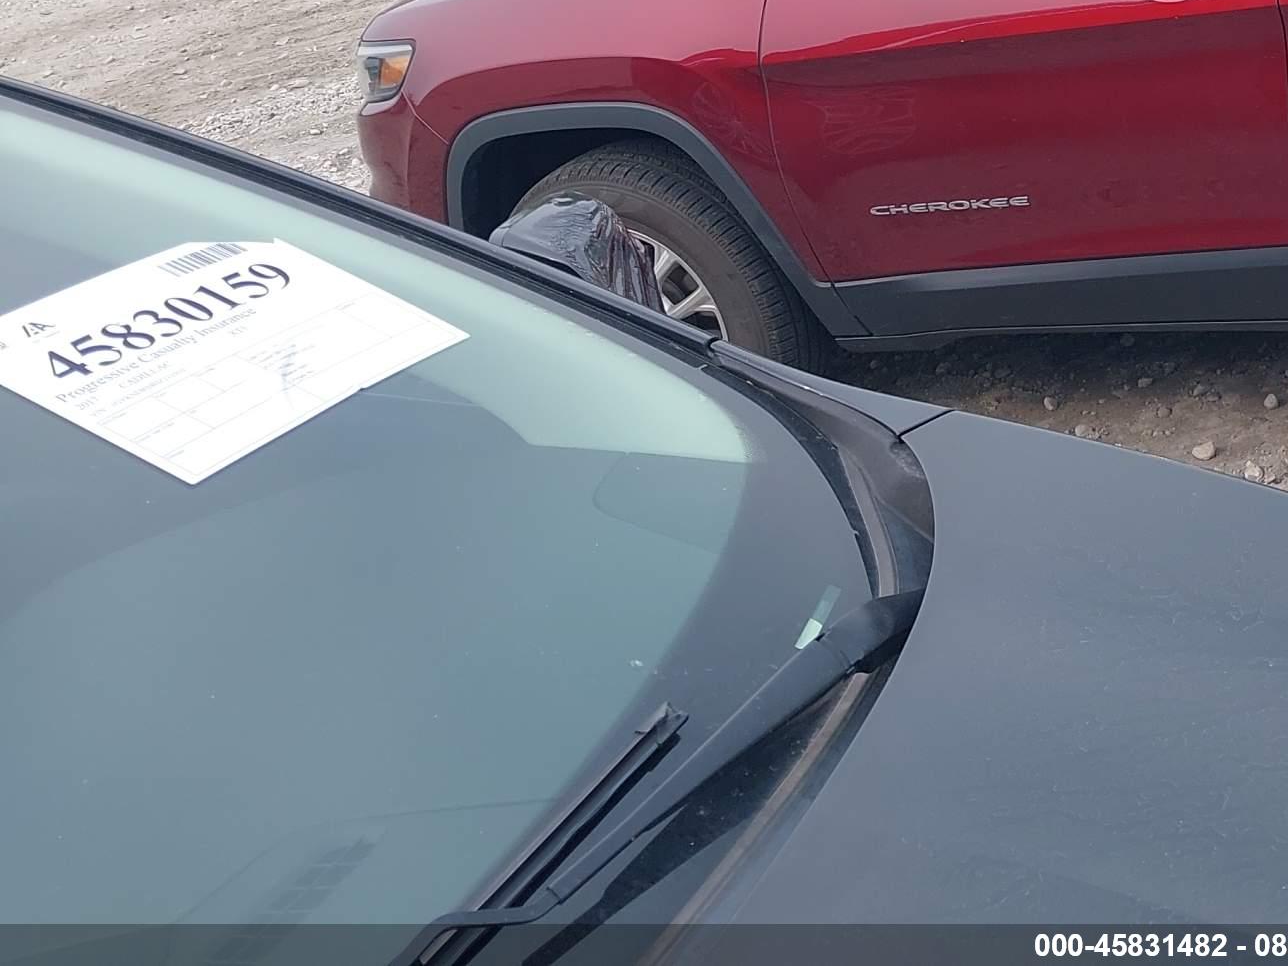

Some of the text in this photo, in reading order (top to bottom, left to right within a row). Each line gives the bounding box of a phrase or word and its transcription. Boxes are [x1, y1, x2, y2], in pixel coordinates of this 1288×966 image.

[869, 195, 1031, 216] CHEROKEE
[47, 263, 291, 379] 45830159
[55, 360, 140, 403] Progressive
[137, 333, 199, 364] Casualty
[194, 307, 257, 338] Insurance
